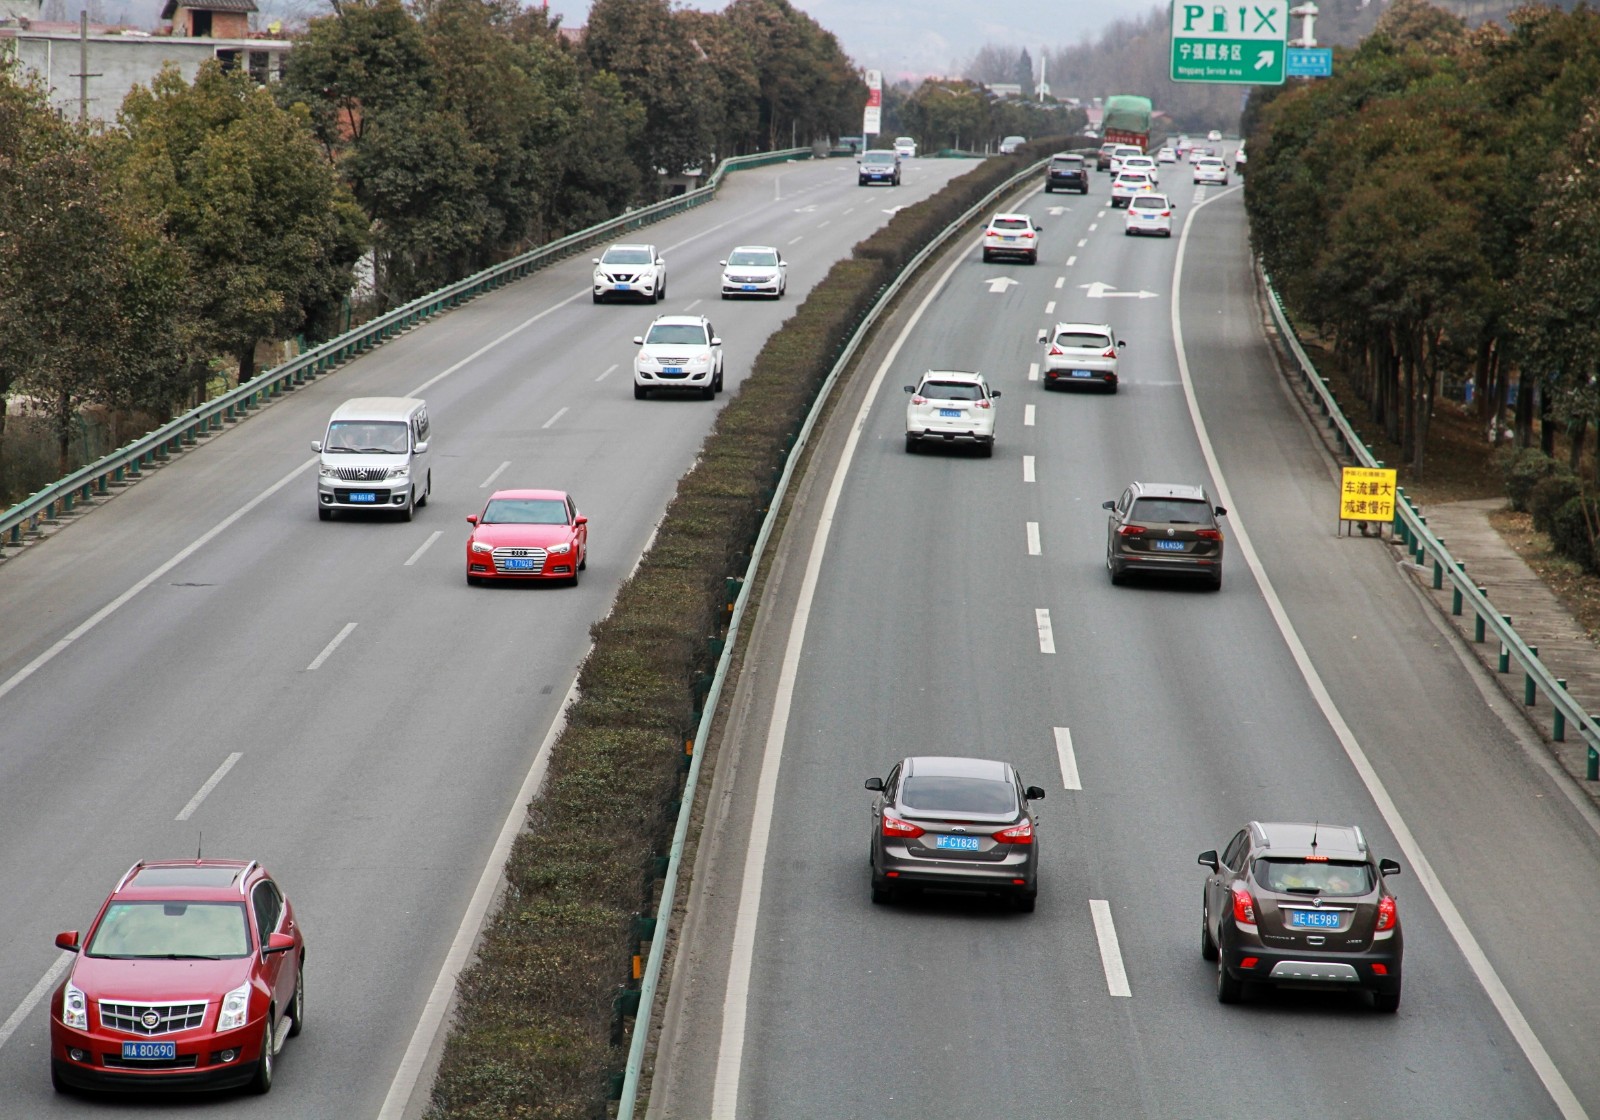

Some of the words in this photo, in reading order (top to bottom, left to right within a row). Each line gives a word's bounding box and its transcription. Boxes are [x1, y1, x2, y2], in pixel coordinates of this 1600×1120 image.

[1183, 5, 1204, 31] P
[1180, 43, 1242, 61] 宁强服务区
[1206, 66, 1227, 76] Service
[1229, 67, 1242, 76] Area
[1344, 481, 1392, 496] 车流量大
[1344, 500, 1391, 515] 减速慢行
